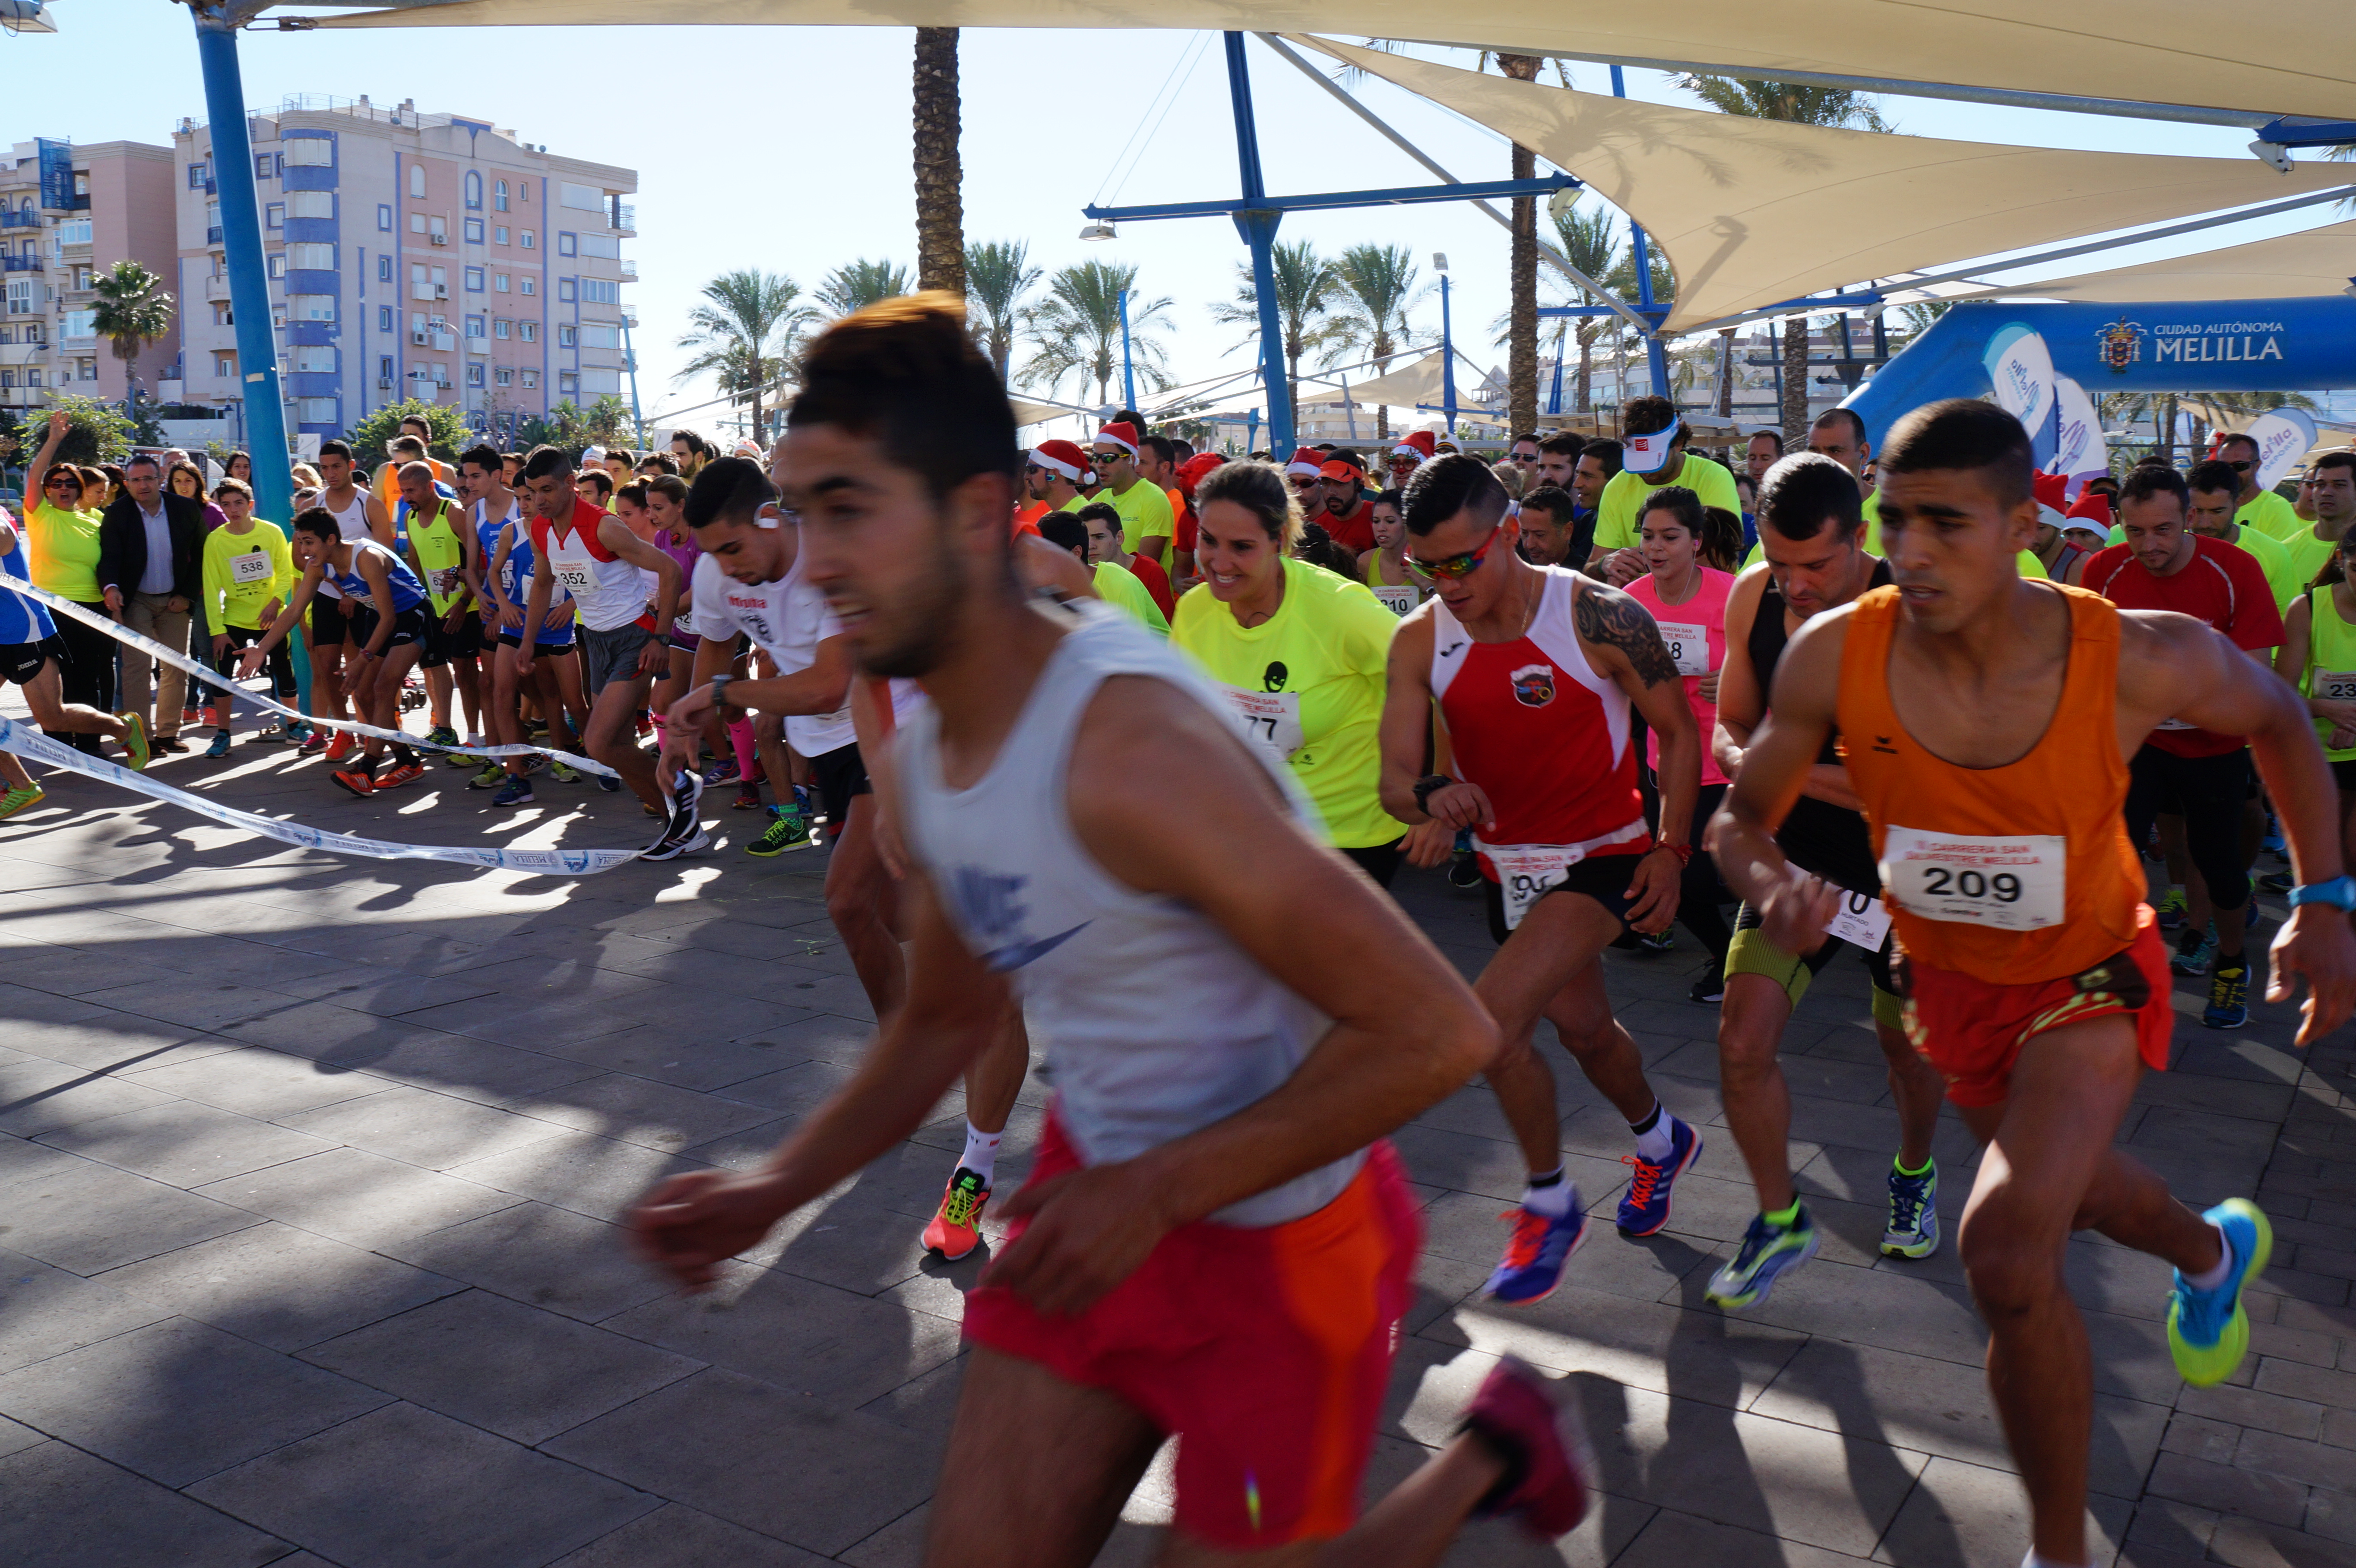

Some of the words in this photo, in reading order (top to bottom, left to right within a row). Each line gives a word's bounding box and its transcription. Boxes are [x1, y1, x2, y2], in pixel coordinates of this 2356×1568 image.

[2153, 324, 2202, 335] CIUDAD
[2204, 321, 2284, 334] AUTÓNOMA
[2155, 336, 2284, 362] MELILLA
[2261, 427, 2293, 460] elilla
[241, 561, 263, 573] 538
[560, 572, 588, 585] 352
[1254, 705, 1286, 713] MELILLA
[1929, 842, 1996, 854] CARRERA
[2000, 844, 2031, 854] SAN
[513, 853, 556, 863] MELILLA
[1982, 856, 2042, 865] MELILLA
[1923, 867, 2022, 903] 209
[1841, 912, 1869, 926] HURTADO
